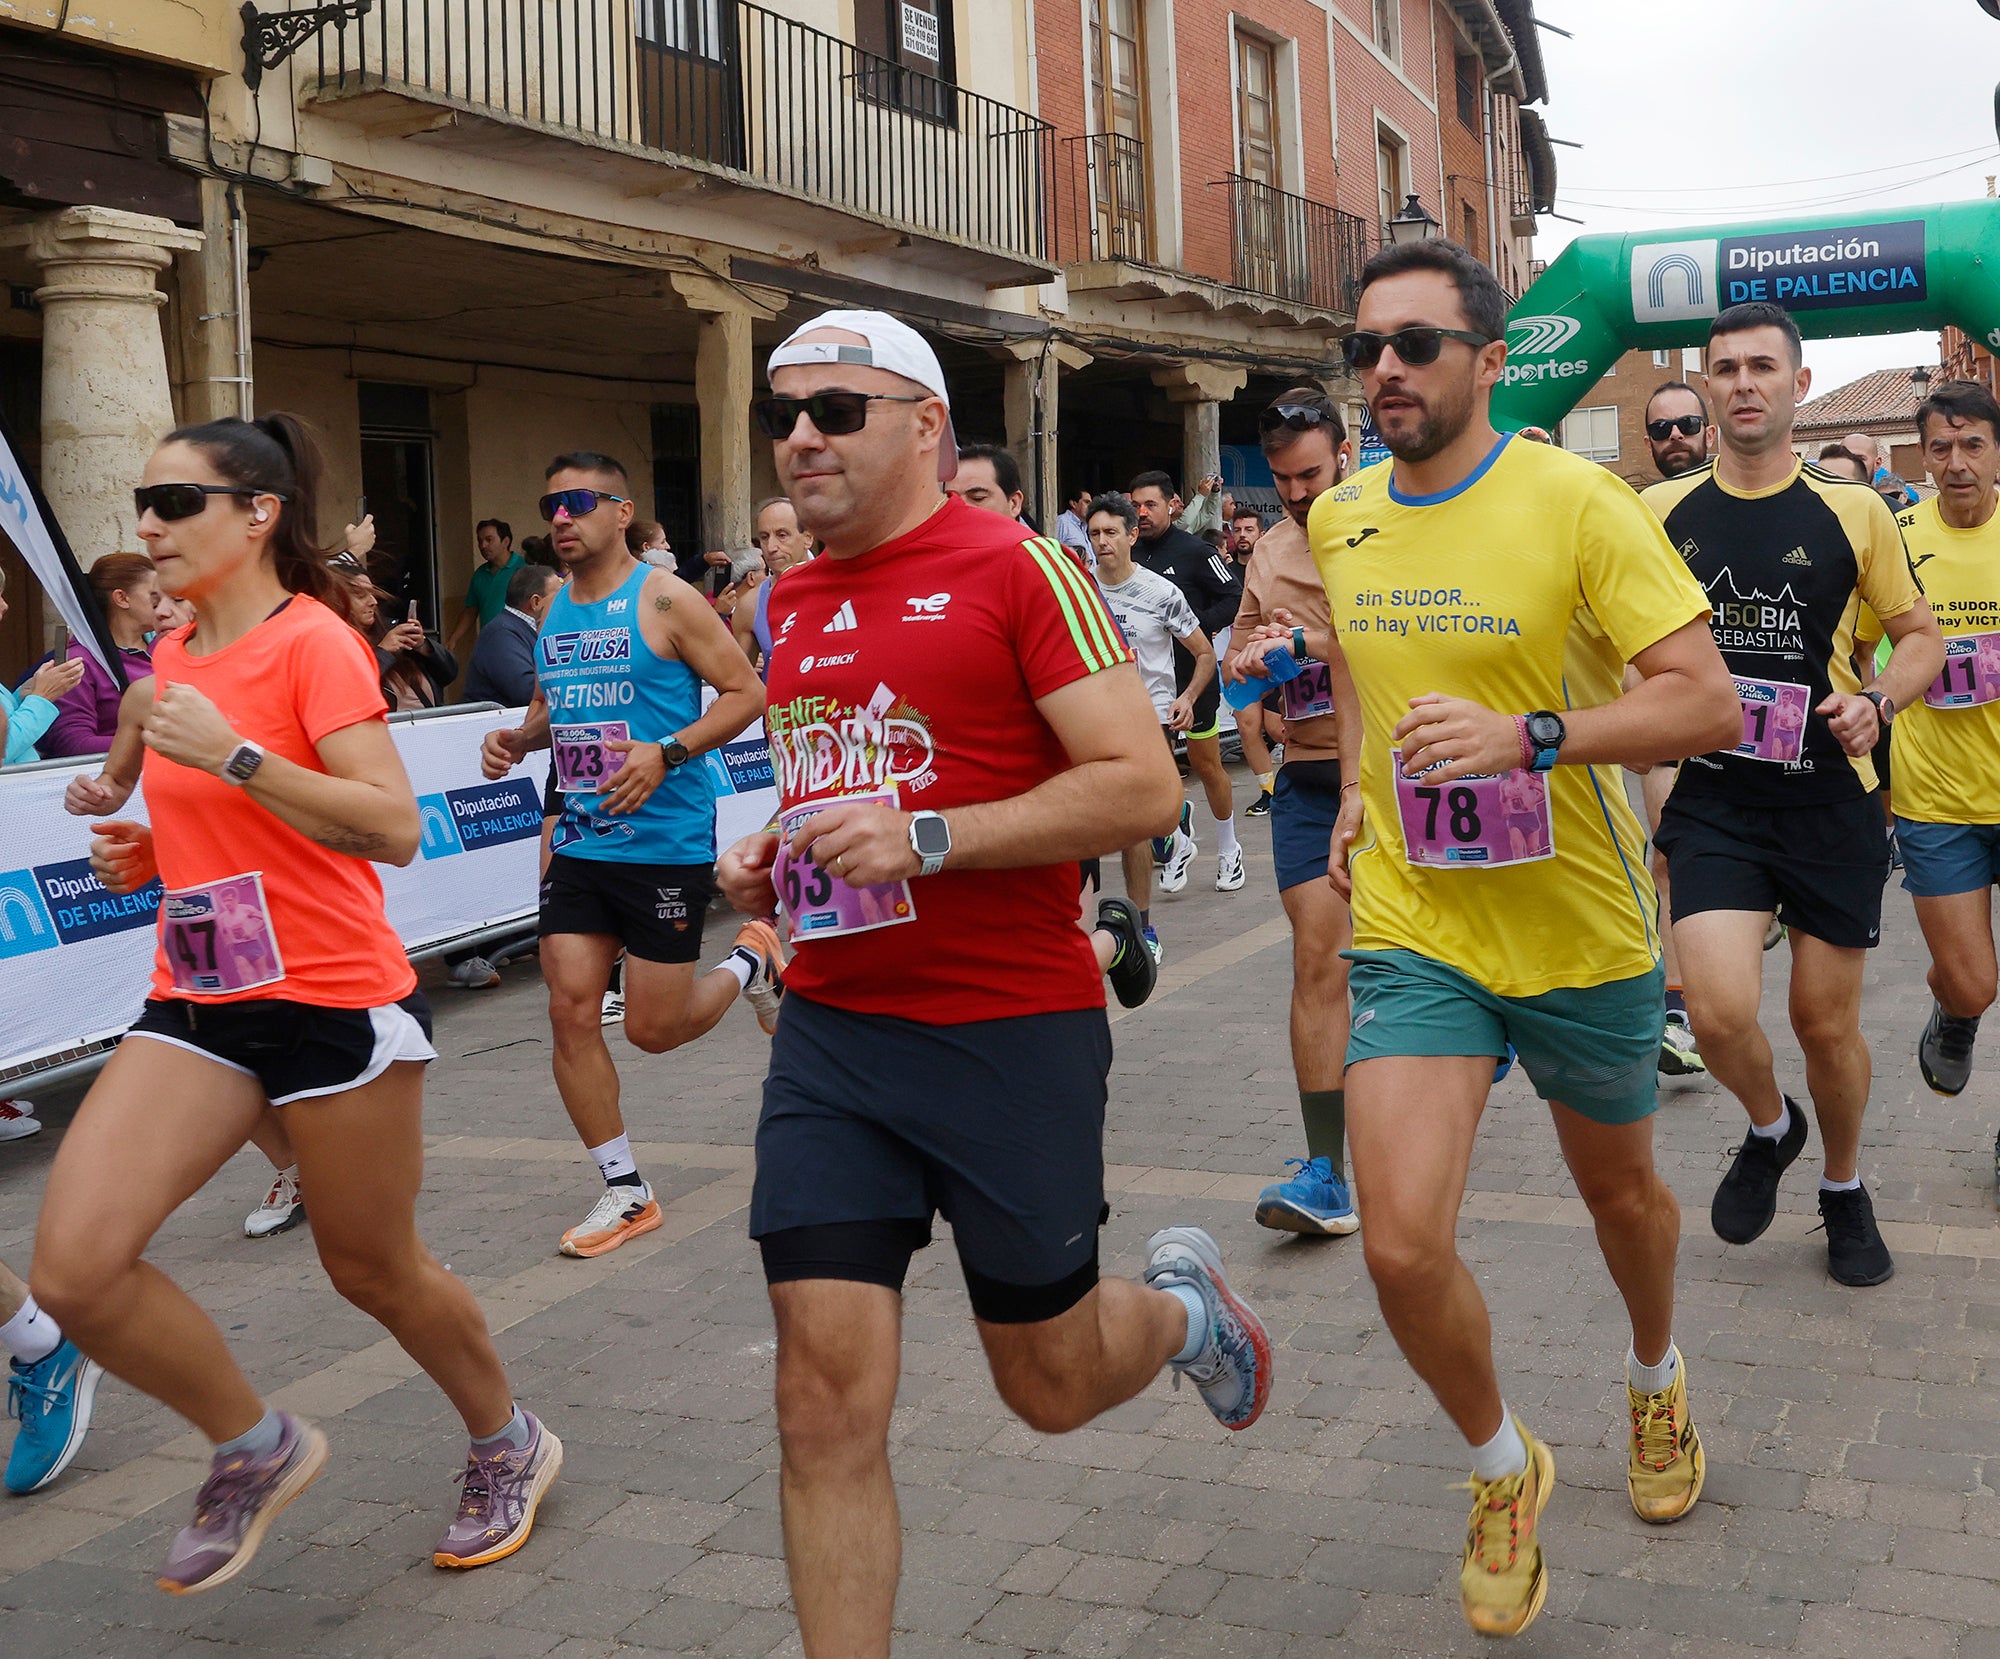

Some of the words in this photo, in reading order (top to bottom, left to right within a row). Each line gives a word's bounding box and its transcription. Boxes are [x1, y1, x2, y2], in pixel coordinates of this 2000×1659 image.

[905, 8, 913, 23] SE
[914, 12, 936, 33] VENDE
[905, 24, 915, 37] 655
[1729, 238, 1880, 272] Diputación
[1730, 279, 1768, 303] DE
[1776, 266, 1919, 299] PALENCIA
[1334, 485, 1362, 502] GERO
[1782, 556, 1812, 567] adidas
[607, 599, 628, 613] HH
[1356, 589, 1382, 606] sin
[1391, 589, 1481, 606] SUDOR...
[581, 628, 630, 640] COMERCIAL
[1376, 616, 1410, 636] hay
[1416, 615, 1521, 636] VICTORIA
[580, 639, 630, 661] ULSA
[1713, 629, 1804, 650] SEBASTIAN
[816, 650, 859, 668] ZURICH
[580, 664, 631, 676] INDUSTRIALES
[1289, 665, 1332, 704] 154
[768, 696, 826, 735] SIENTE
[557, 744, 603, 777] 123
[732, 771, 747, 784] DE
[452, 791, 521, 818] Diputación
[1415, 787, 1481, 842] 78
[461, 823, 482, 840] DE
[481, 810, 544, 835] PALENCIA
[57, 906, 88, 929] DE
[658, 907, 687, 919] ULSA
[174, 920, 218, 970] 47
